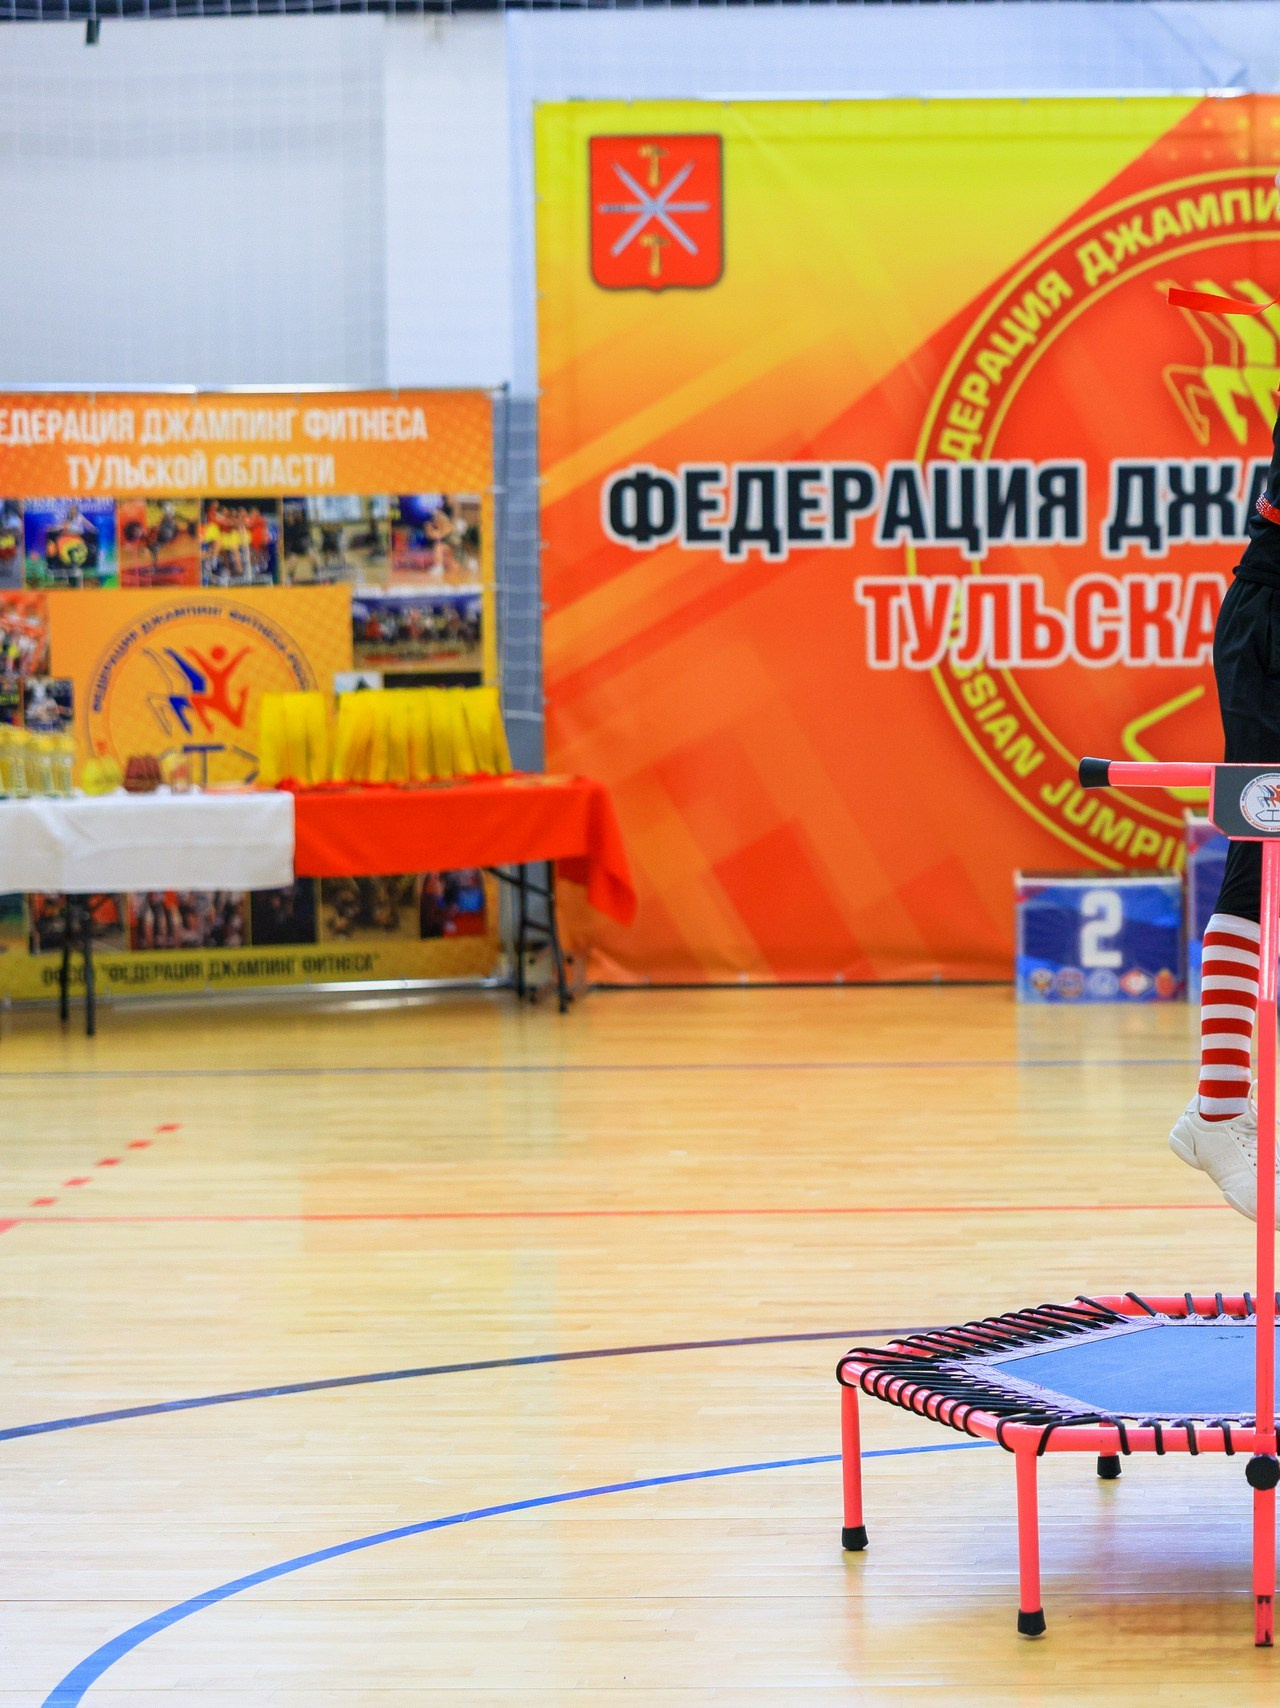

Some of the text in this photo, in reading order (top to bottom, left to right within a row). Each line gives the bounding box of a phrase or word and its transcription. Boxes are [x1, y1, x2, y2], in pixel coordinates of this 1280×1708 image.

[940, 270, 1072, 461] ДЕРАЦИЯ
[0, 405, 428, 446] ЕДЕРАЦИЯ ДЖАМПИНГ ФИТНЕСА
[67, 449, 335, 488] ТУЛЬСКОЙ ОБЛАСТИ
[604, 459, 1086, 562] ФЕДЕРАЦИЯ
[855, 573, 1216, 669] ТУЛЬСКА
[951, 660, 1045, 778] SIAN
[1041, 779, 1187, 872] JUMPI
[208, 956, 296, 981] ДЖАМПИНГ
[1081, 889, 1122, 968] 2
